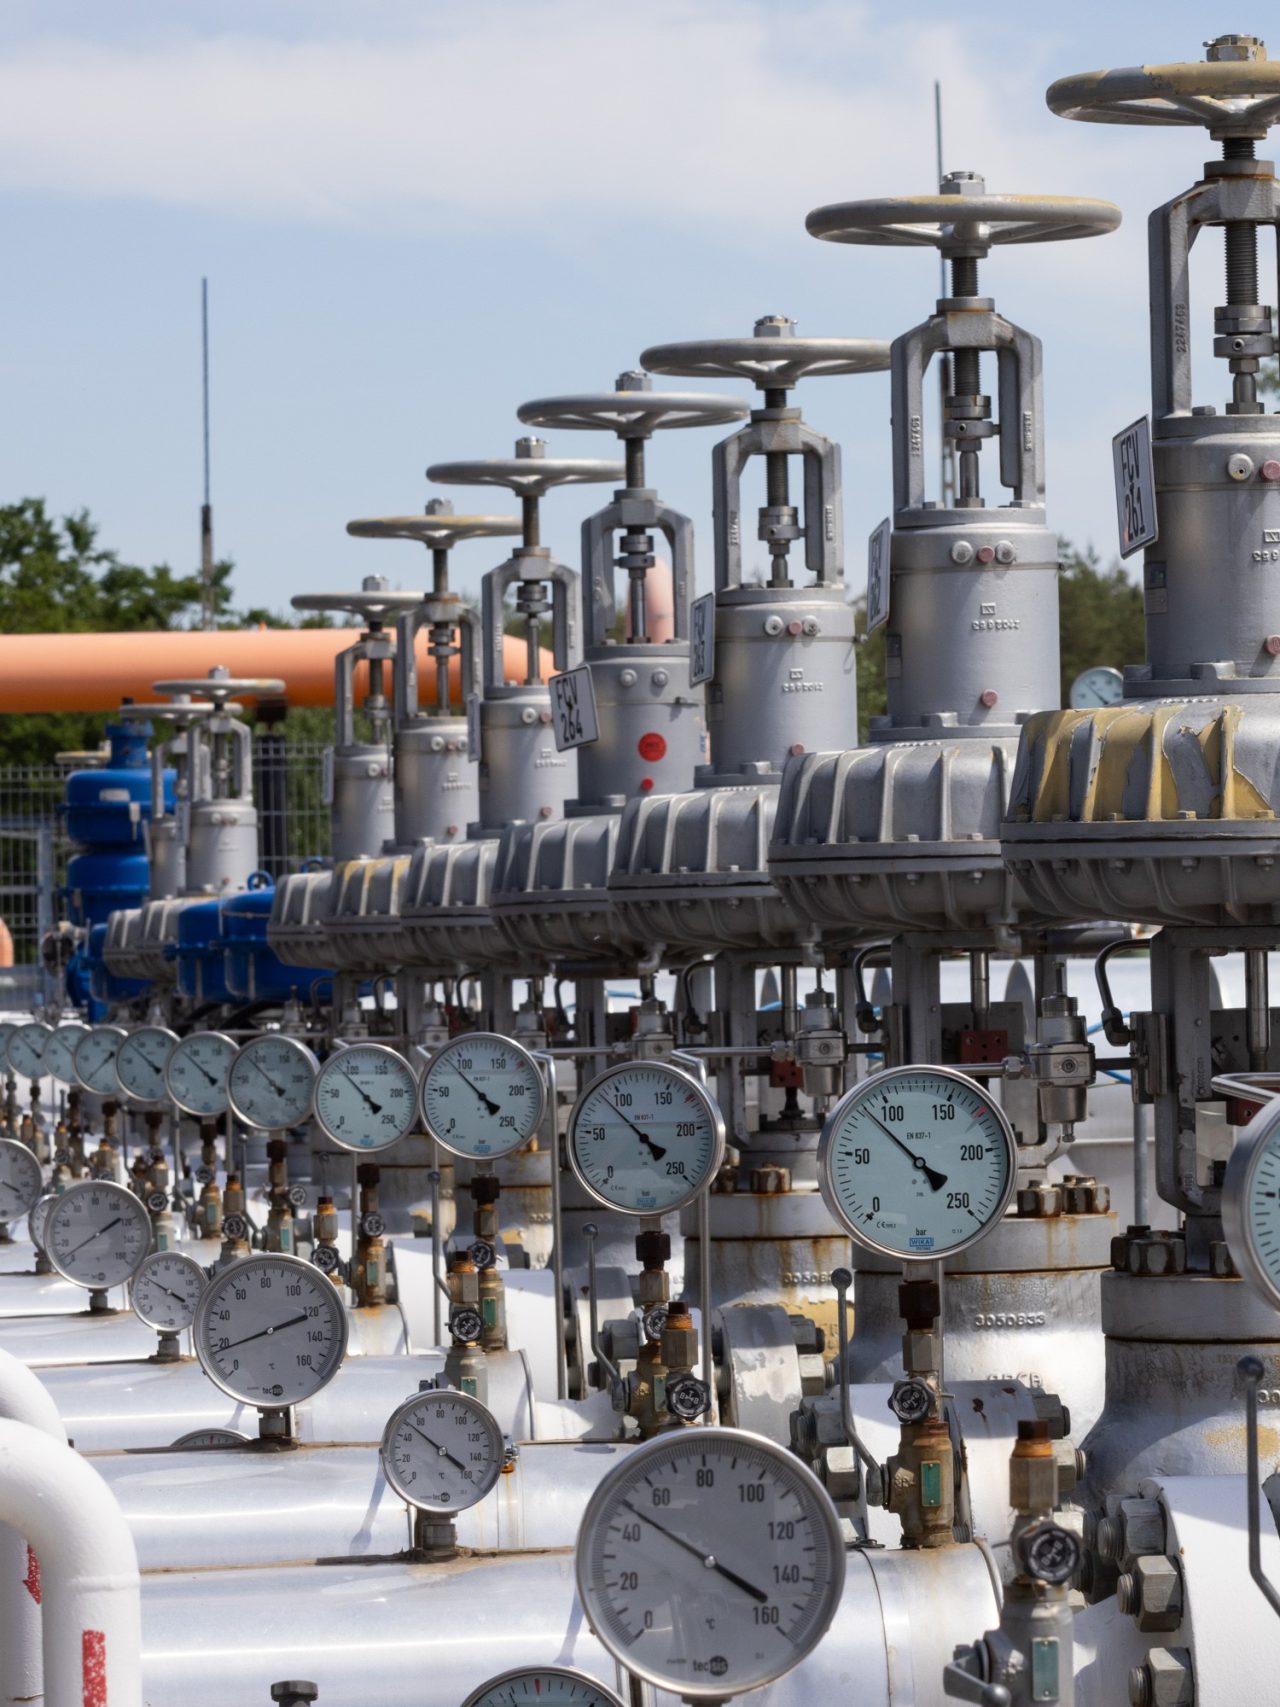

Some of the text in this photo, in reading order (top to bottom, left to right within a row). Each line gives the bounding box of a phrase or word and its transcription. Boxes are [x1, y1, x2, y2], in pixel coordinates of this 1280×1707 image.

[1121, 430, 1140, 487] FCV
[1125, 487, 1145, 541] 261
[556, 675, 578, 709] FCV
[561, 709, 583, 743] 264
[458, 1059, 472, 1069] 100
[491, 1059, 506, 1069] 150
[439, 1087, 449, 1097] 50
[509, 1085, 524, 1096] 200
[614, 1093, 632, 1106] 100
[654, 1092, 672, 1105] 150
[881, 1106, 904, 1122] 100
[932, 1105, 955, 1121] 150
[450, 1118, 455, 1129] 0
[499, 1116, 515, 1127] 250
[593, 1128, 605, 1141] 50
[676, 1124, 695, 1137] 200
[855, 1149, 870, 1165] 50
[960, 1145, 983, 1161] 200
[607, 1166, 613, 1178] 0
[666, 1162, 684, 1175] 250
[872, 1197, 880, 1212] 0
[947, 1193, 969, 1209] 250
[915, 1228, 927, 1236] bar
[261, 1278, 271, 1288] 80
[236, 1289, 246, 1300] 60
[286, 1285, 300, 1296] 100
[219, 1310, 230, 1321] 40
[304, 1306, 319, 1317] 120
[307, 1331, 323, 1342] 140
[219, 1338, 229, 1348] 20
[234, 1360, 239, 1370] 0
[296, 1355, 312, 1366] 160
[436, 1410, 444, 1418] 80
[416, 1418, 425, 1426] 60
[455, 1416, 467, 1425] 100
[404, 1433, 412, 1441] 40
[468, 1433, 479, 1441] 120
[402, 1454, 410, 1462] 20
[470, 1452, 481, 1461] 140
[461, 1471, 472, 1479] 160
[696, 1469, 714, 1487] 80
[652, 1488, 670, 1506] 60
[738, 1484, 765, 1503] 100
[623, 1524, 641, 1542] 40
[768, 1522, 794, 1540] 120
[773, 1565, 799, 1584] 140
[620, 1572, 638, 1590] 20
[644, 1611, 653, 1628] 0
[753, 1606, 779, 1624] 160
